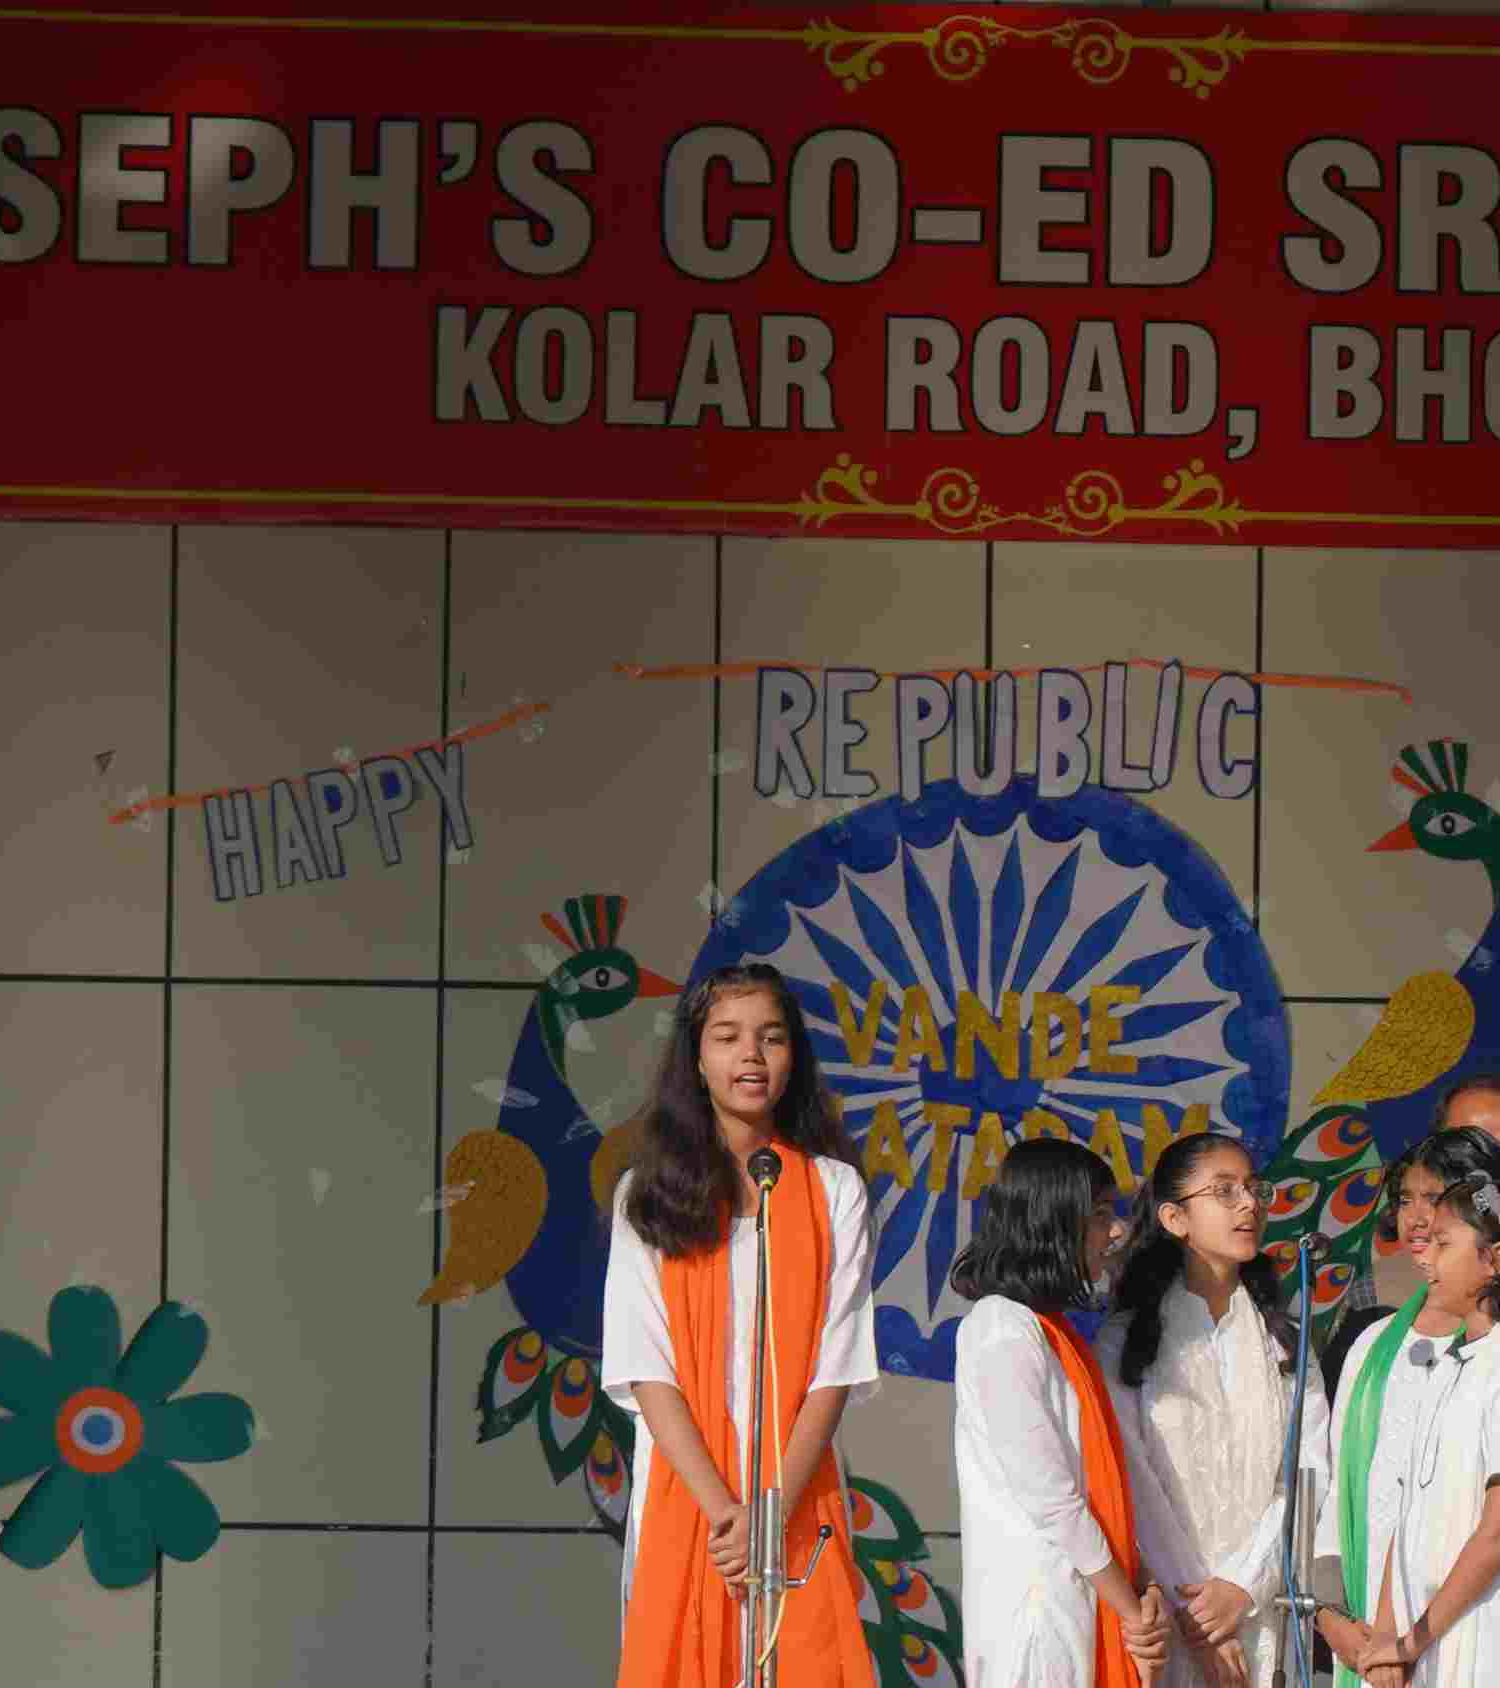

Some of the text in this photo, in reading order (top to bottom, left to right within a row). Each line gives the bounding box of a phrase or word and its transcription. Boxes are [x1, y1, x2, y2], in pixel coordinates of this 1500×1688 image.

[660, 123, 1216, 291] CO-ED
[431, 305, 837, 436] KOLAR
[883, 316, 1259, 459] ROAD,
[753, 658, 1259, 801] REPUBLIC
[200, 740, 474, 902] HAPPY
[830, 981, 1141, 1081] VANDE
